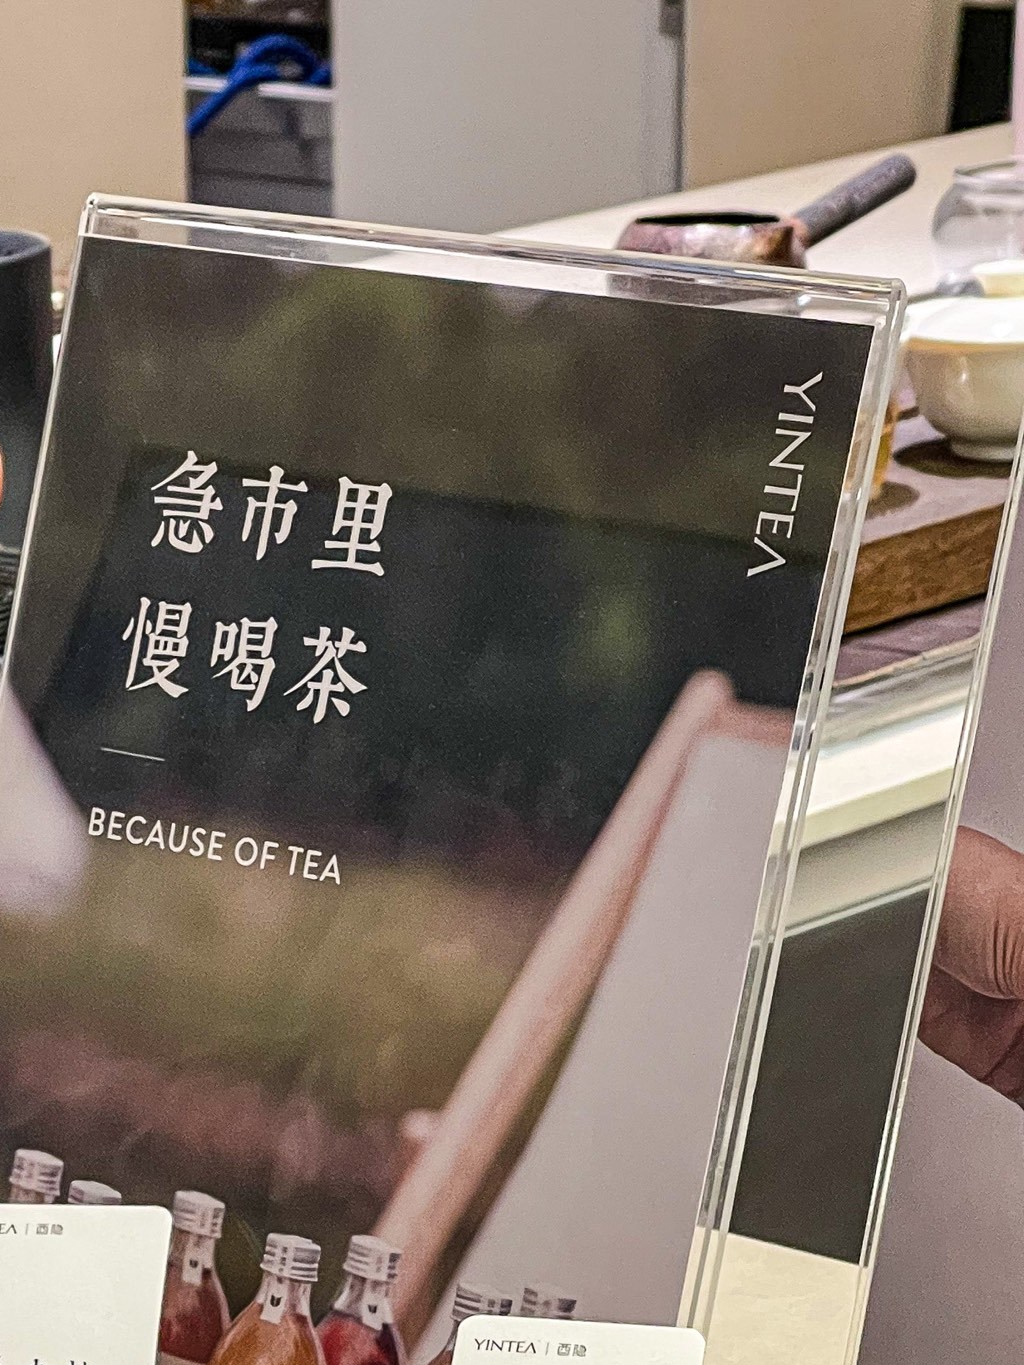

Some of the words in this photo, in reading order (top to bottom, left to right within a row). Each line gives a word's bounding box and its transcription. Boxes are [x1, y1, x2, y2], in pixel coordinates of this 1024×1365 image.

[149, 449, 395, 580] 急市里
[746, 371, 824, 579] YINTEA
[122, 596, 370, 724] 慢喝茶
[87, 807, 226, 862] BECAUSE
[233, 837, 281, 868] OF
[287, 845, 343, 886] TEA
[474, 1338, 537, 1355] YINTEA
